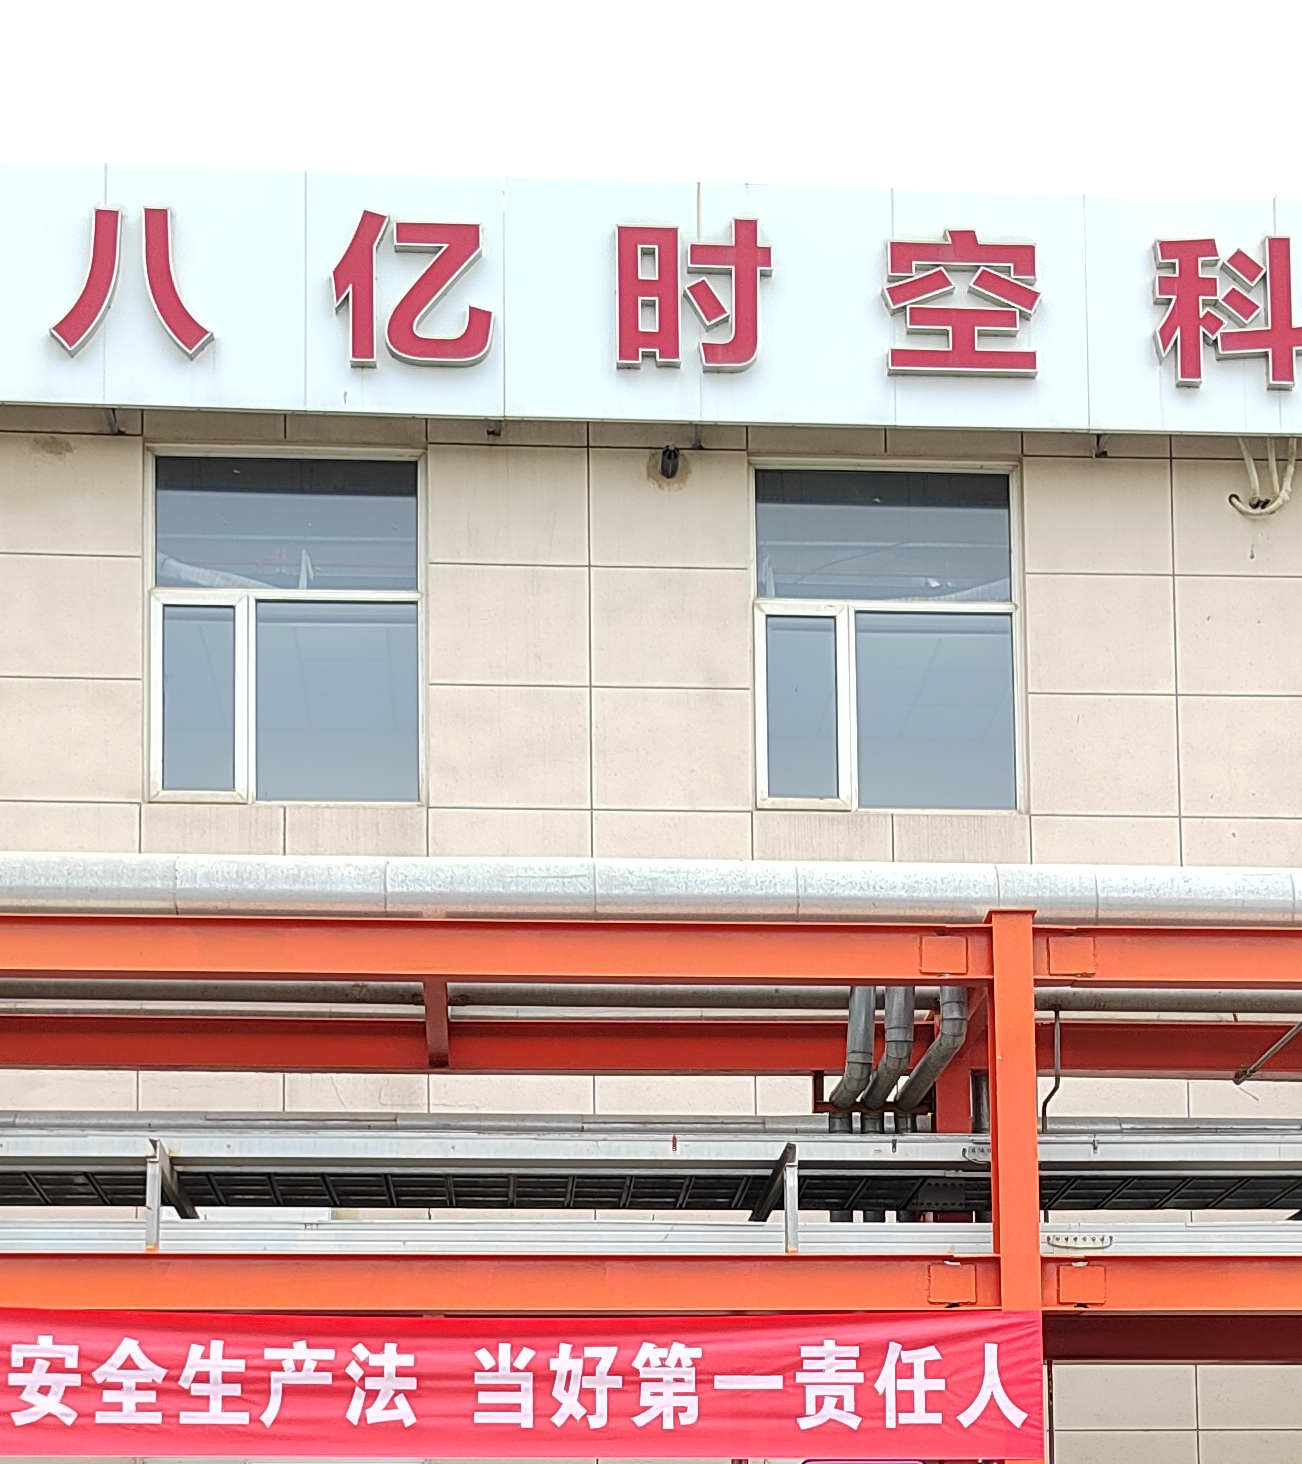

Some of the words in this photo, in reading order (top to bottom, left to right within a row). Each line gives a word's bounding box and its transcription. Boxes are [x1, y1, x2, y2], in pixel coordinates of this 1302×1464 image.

[472, 1338, 1030, 1431] 当好第一责任人
